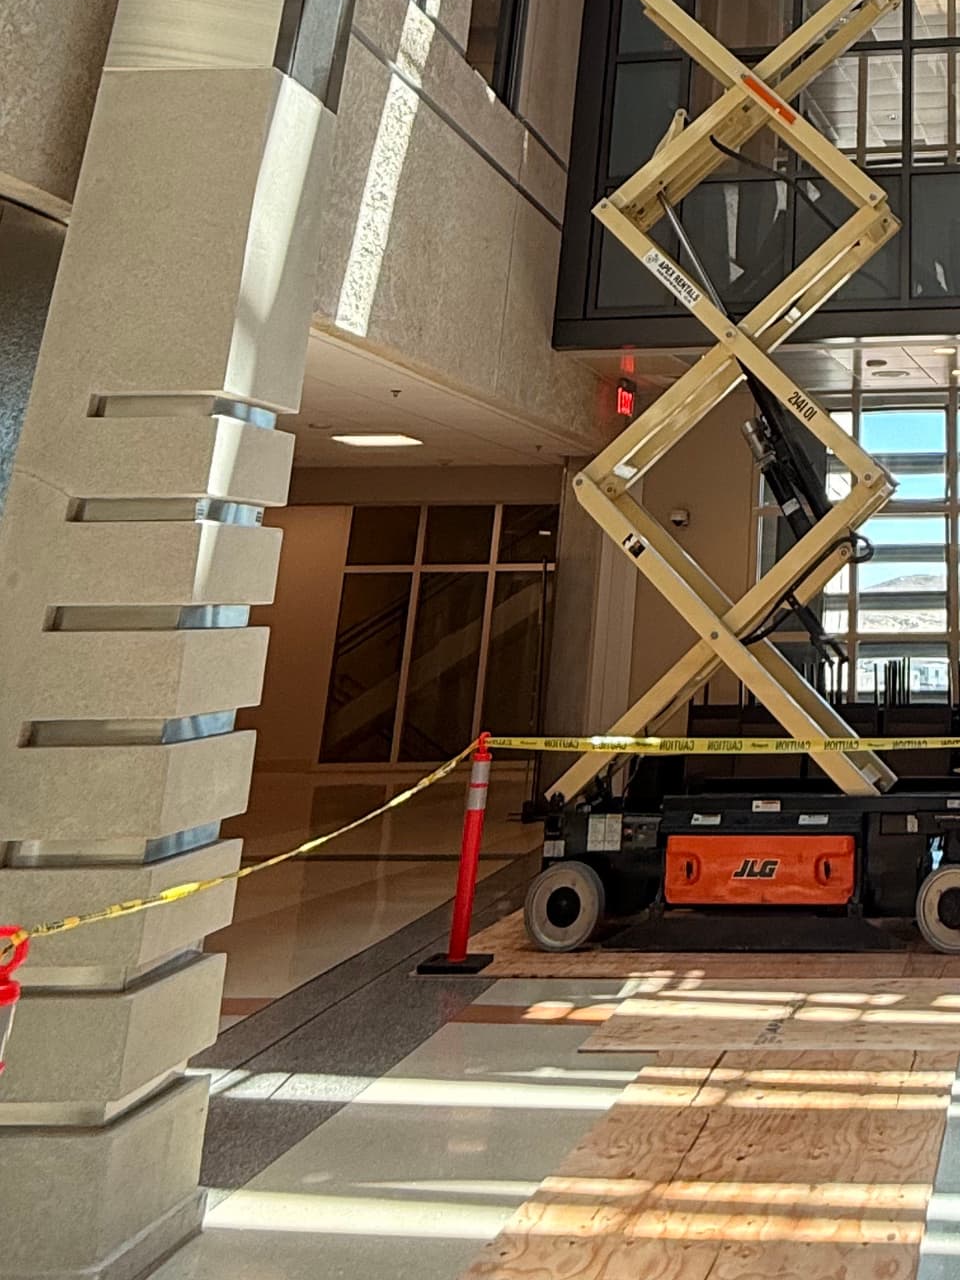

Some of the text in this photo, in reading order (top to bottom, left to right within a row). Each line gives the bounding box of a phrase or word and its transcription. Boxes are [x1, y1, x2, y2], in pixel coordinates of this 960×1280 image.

[658, 260, 701, 302] APEX RENTALS
[732, 858, 780, 879] JLG
